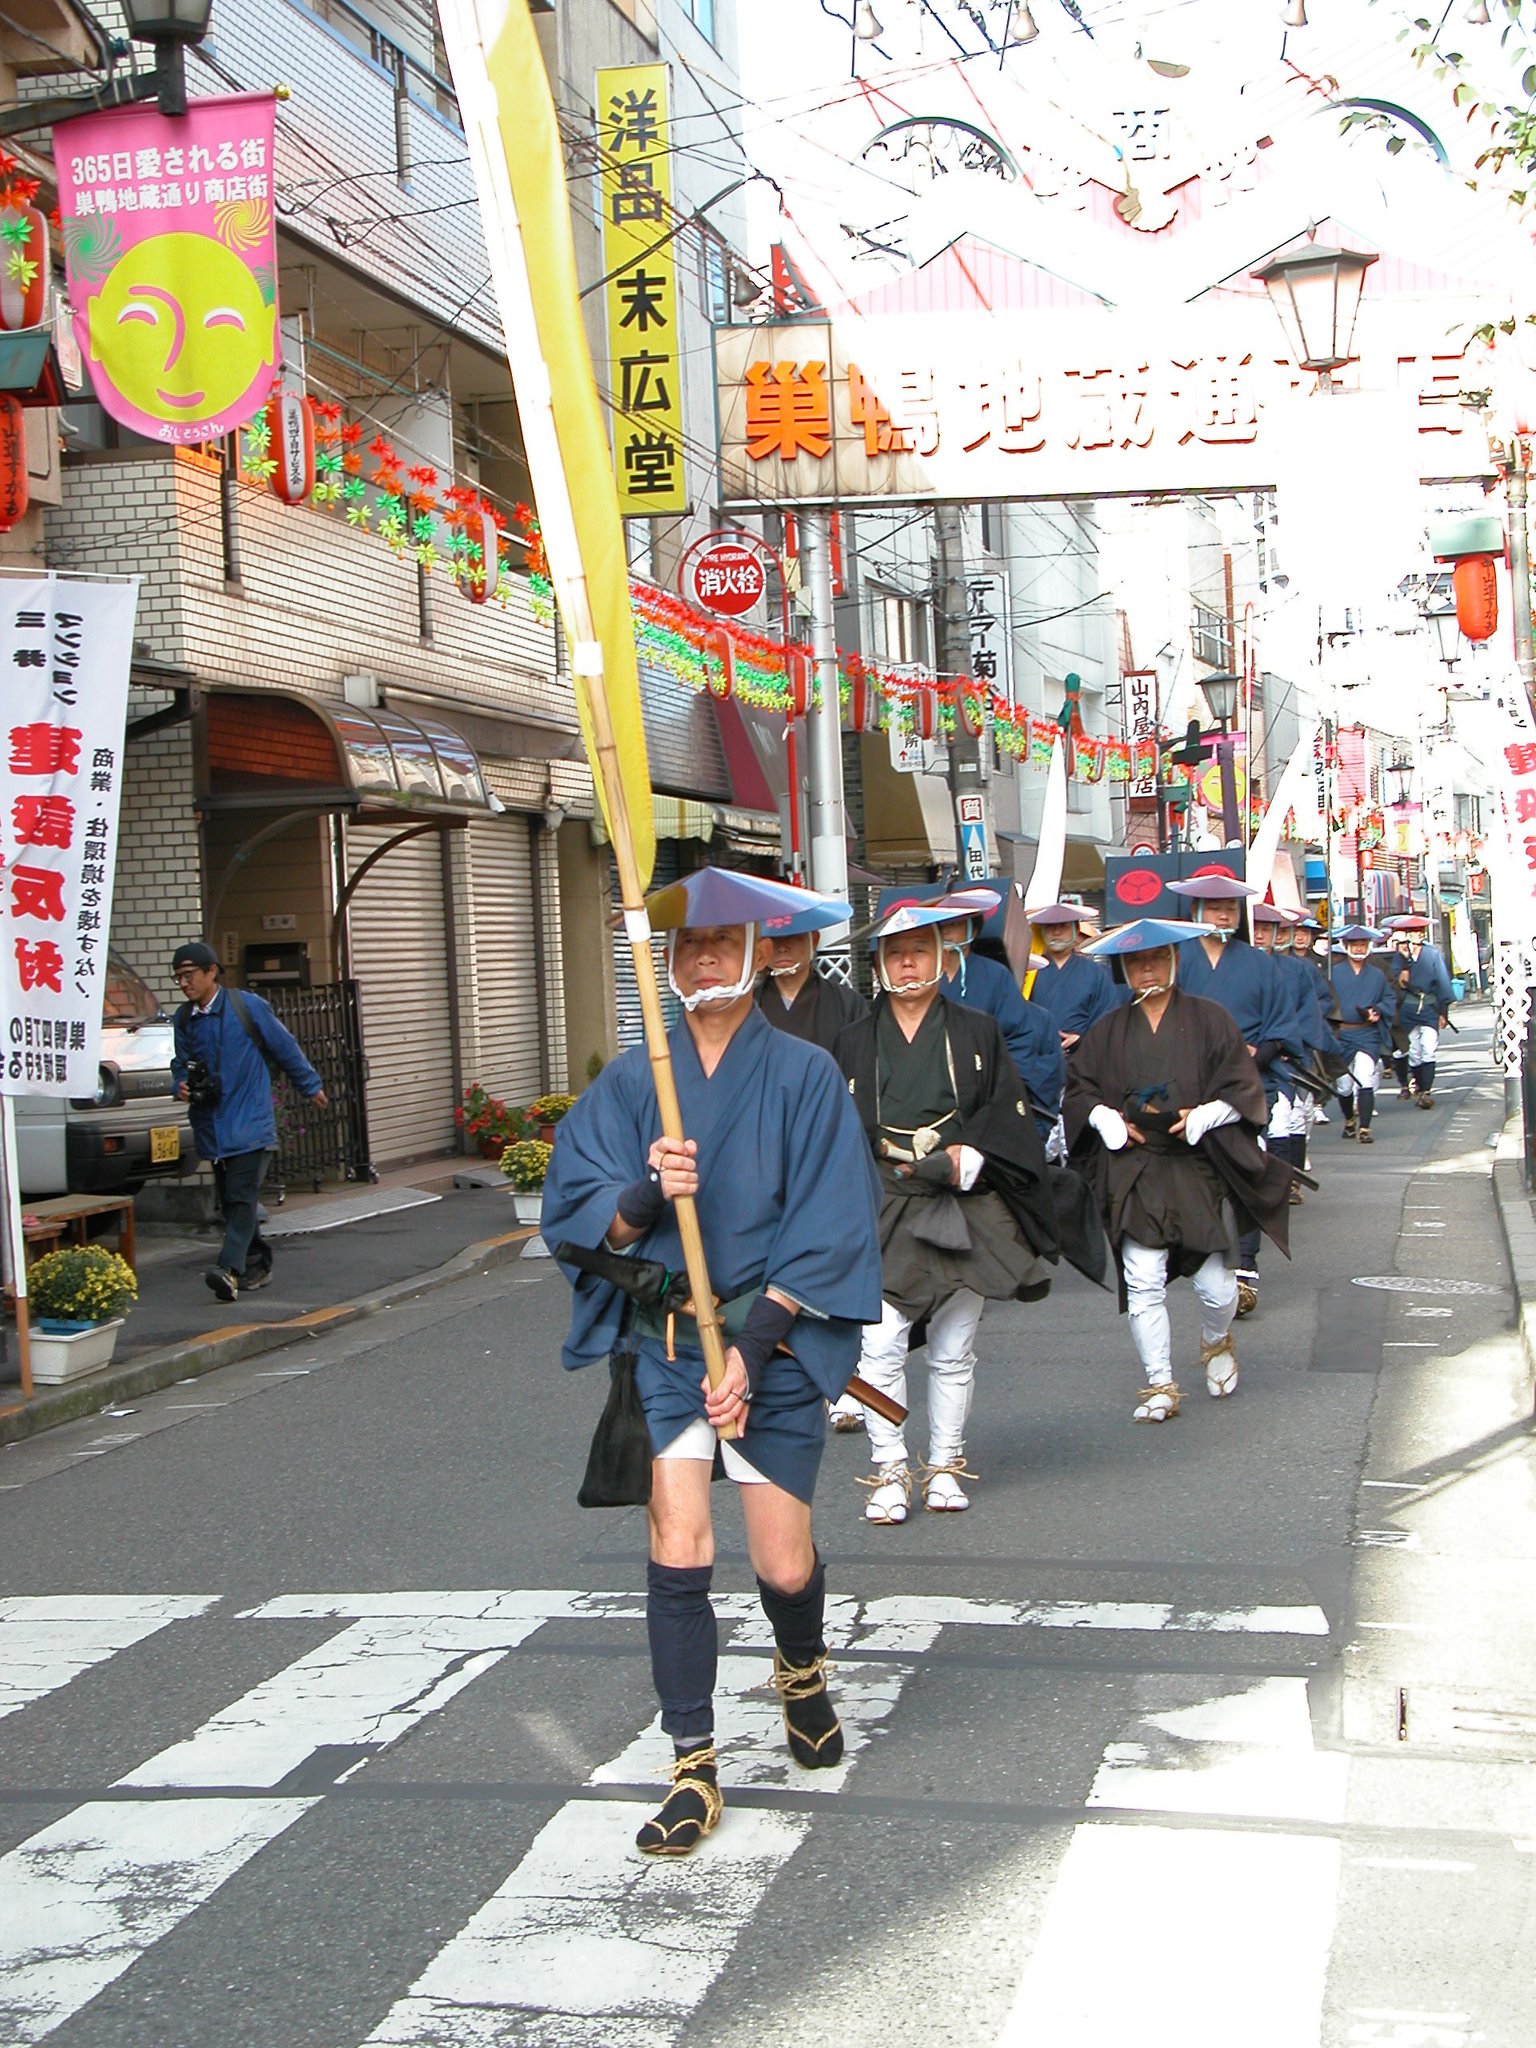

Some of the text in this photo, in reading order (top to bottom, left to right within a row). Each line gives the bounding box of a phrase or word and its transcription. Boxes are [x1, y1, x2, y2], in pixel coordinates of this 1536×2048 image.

[71, 138, 265, 185] 365日愛される街
[75, 173, 268, 216] 巣鴨地蔵通り商店街
[608, 88, 676, 495] 洋品 末広堂
[704, 552, 750, 562] FIRE HYDRANT
[699, 565, 760, 597] 消火栓
[961, 798, 983, 822] 質
[968, 850, 984, 878] 田代
